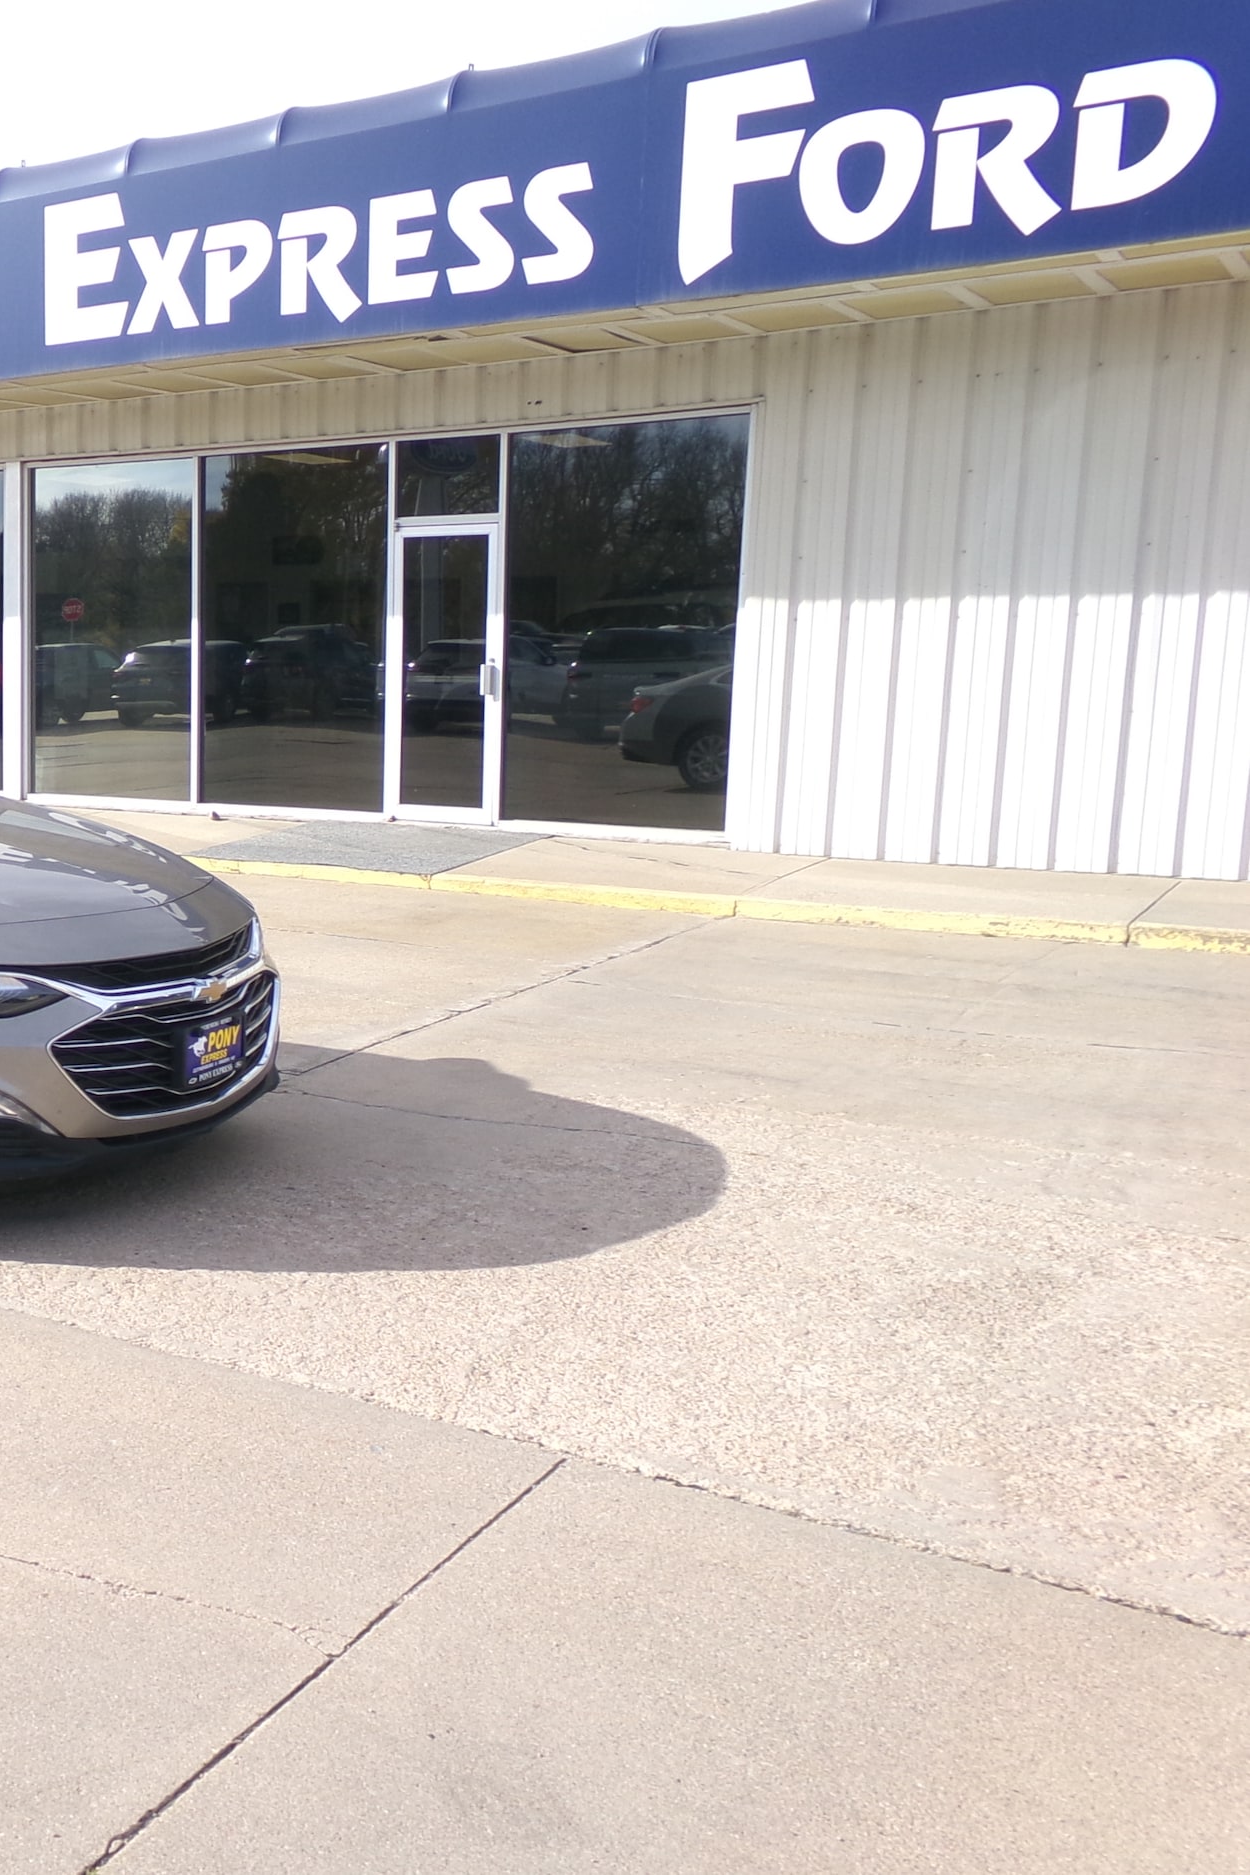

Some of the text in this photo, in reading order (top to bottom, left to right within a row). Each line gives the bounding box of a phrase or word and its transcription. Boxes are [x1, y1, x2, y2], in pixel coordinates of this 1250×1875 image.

[44, 161, 595, 346] EXPRESS
[677, 58, 1218, 286] FORD
[207, 1024, 241, 1053] PONY
